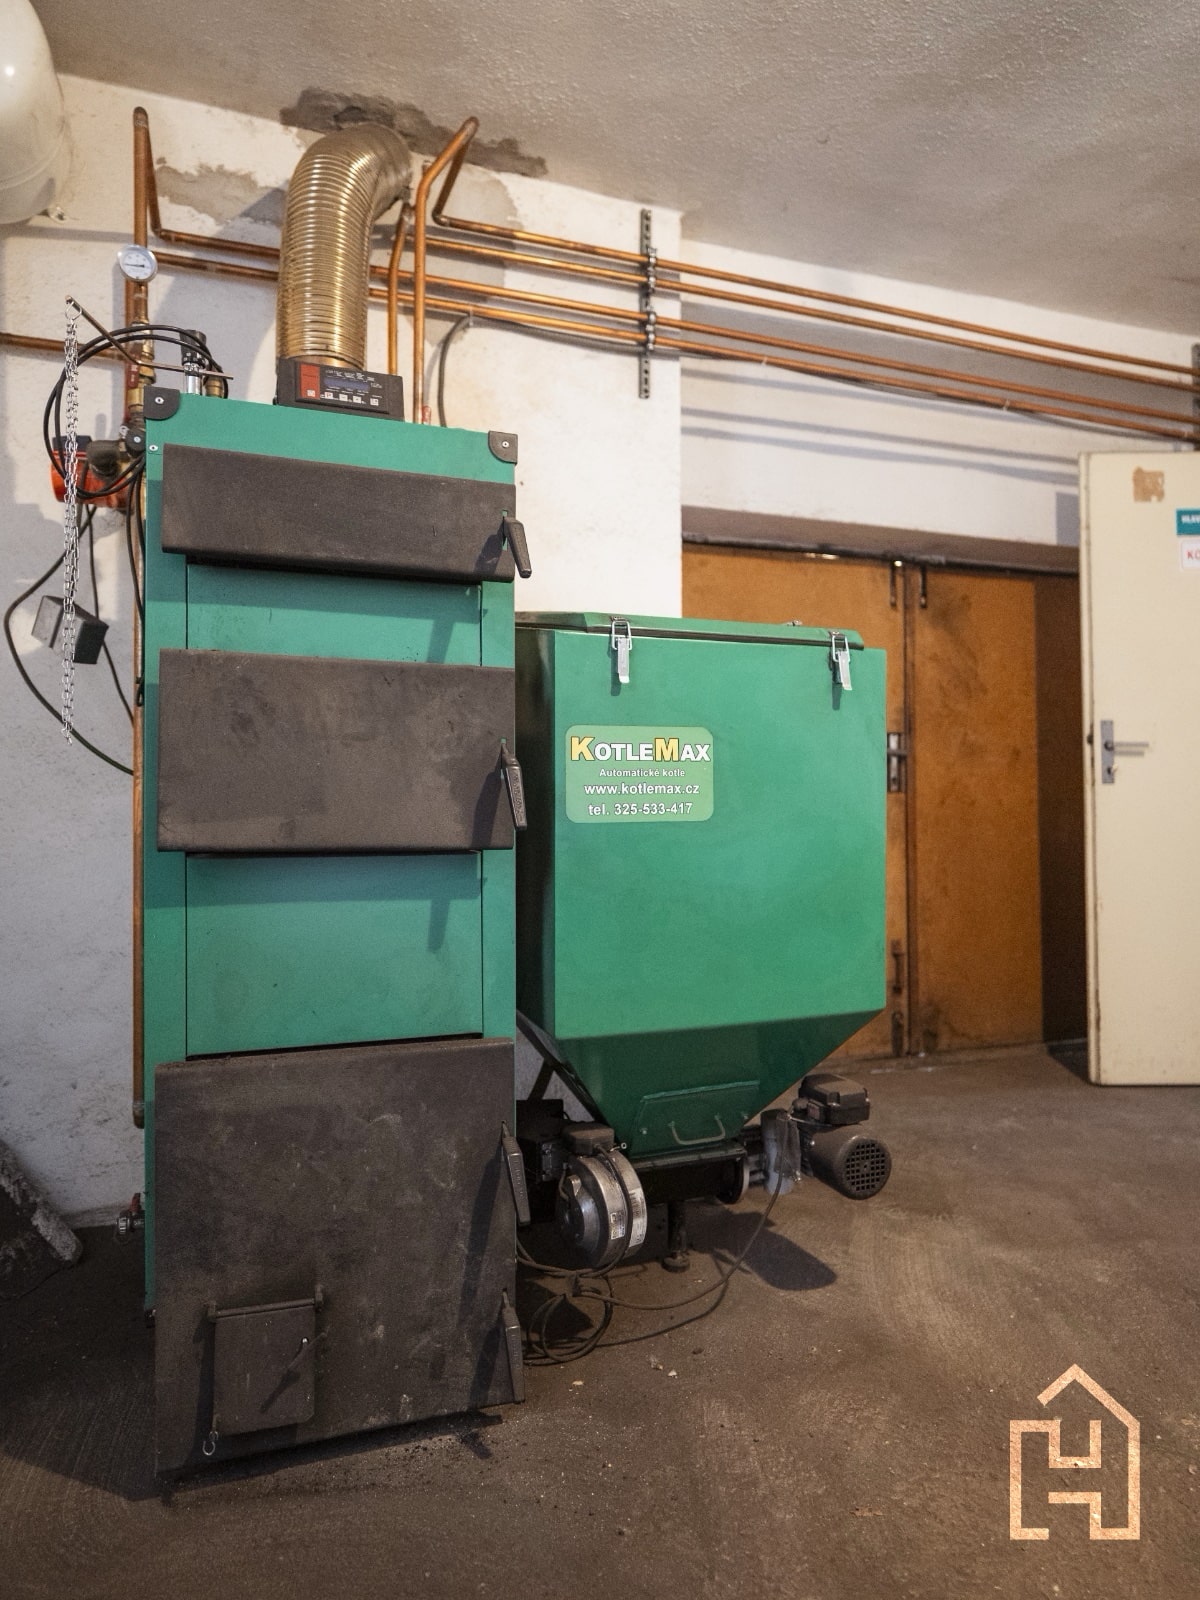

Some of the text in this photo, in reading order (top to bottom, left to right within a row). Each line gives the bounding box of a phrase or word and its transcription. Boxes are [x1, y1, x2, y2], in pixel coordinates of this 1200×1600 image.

[599, 768, 685, 777] Automatické kotle
[584, 782, 699, 795] www.kotlemax.cz
[588, 802, 693, 816] tel. 325-533-417
